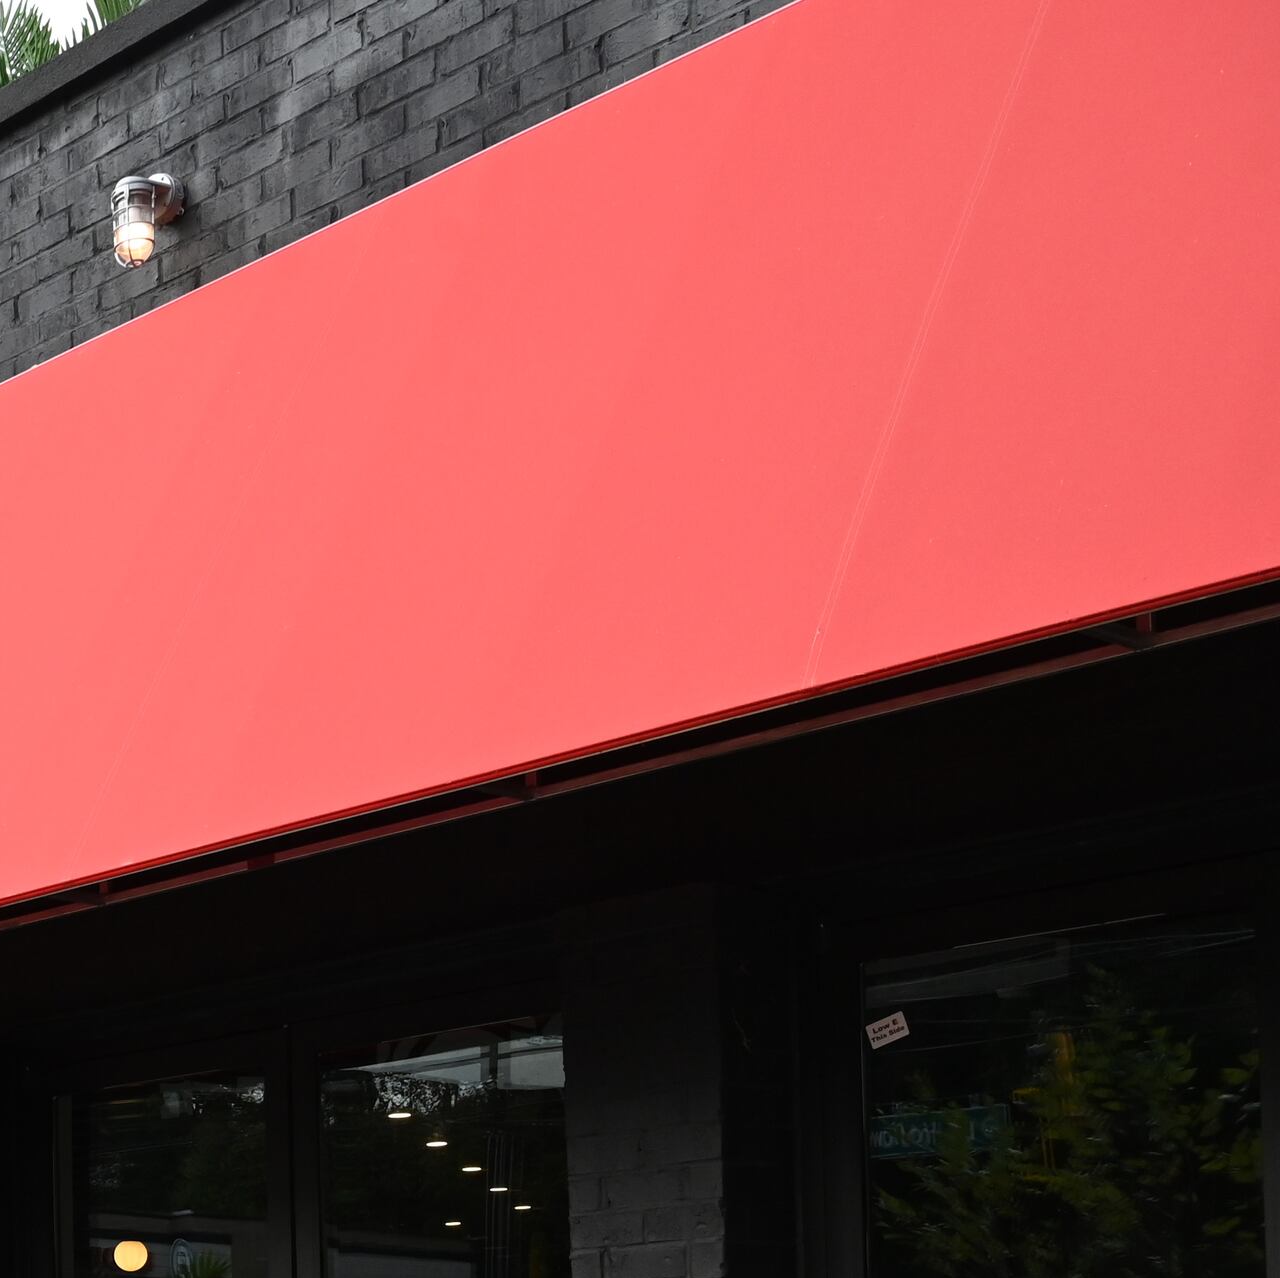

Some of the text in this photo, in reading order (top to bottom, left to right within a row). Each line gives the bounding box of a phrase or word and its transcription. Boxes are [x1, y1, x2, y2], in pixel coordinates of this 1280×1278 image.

[871, 1025, 905, 1043] This Side
[872, 1023, 890, 1034] Low
